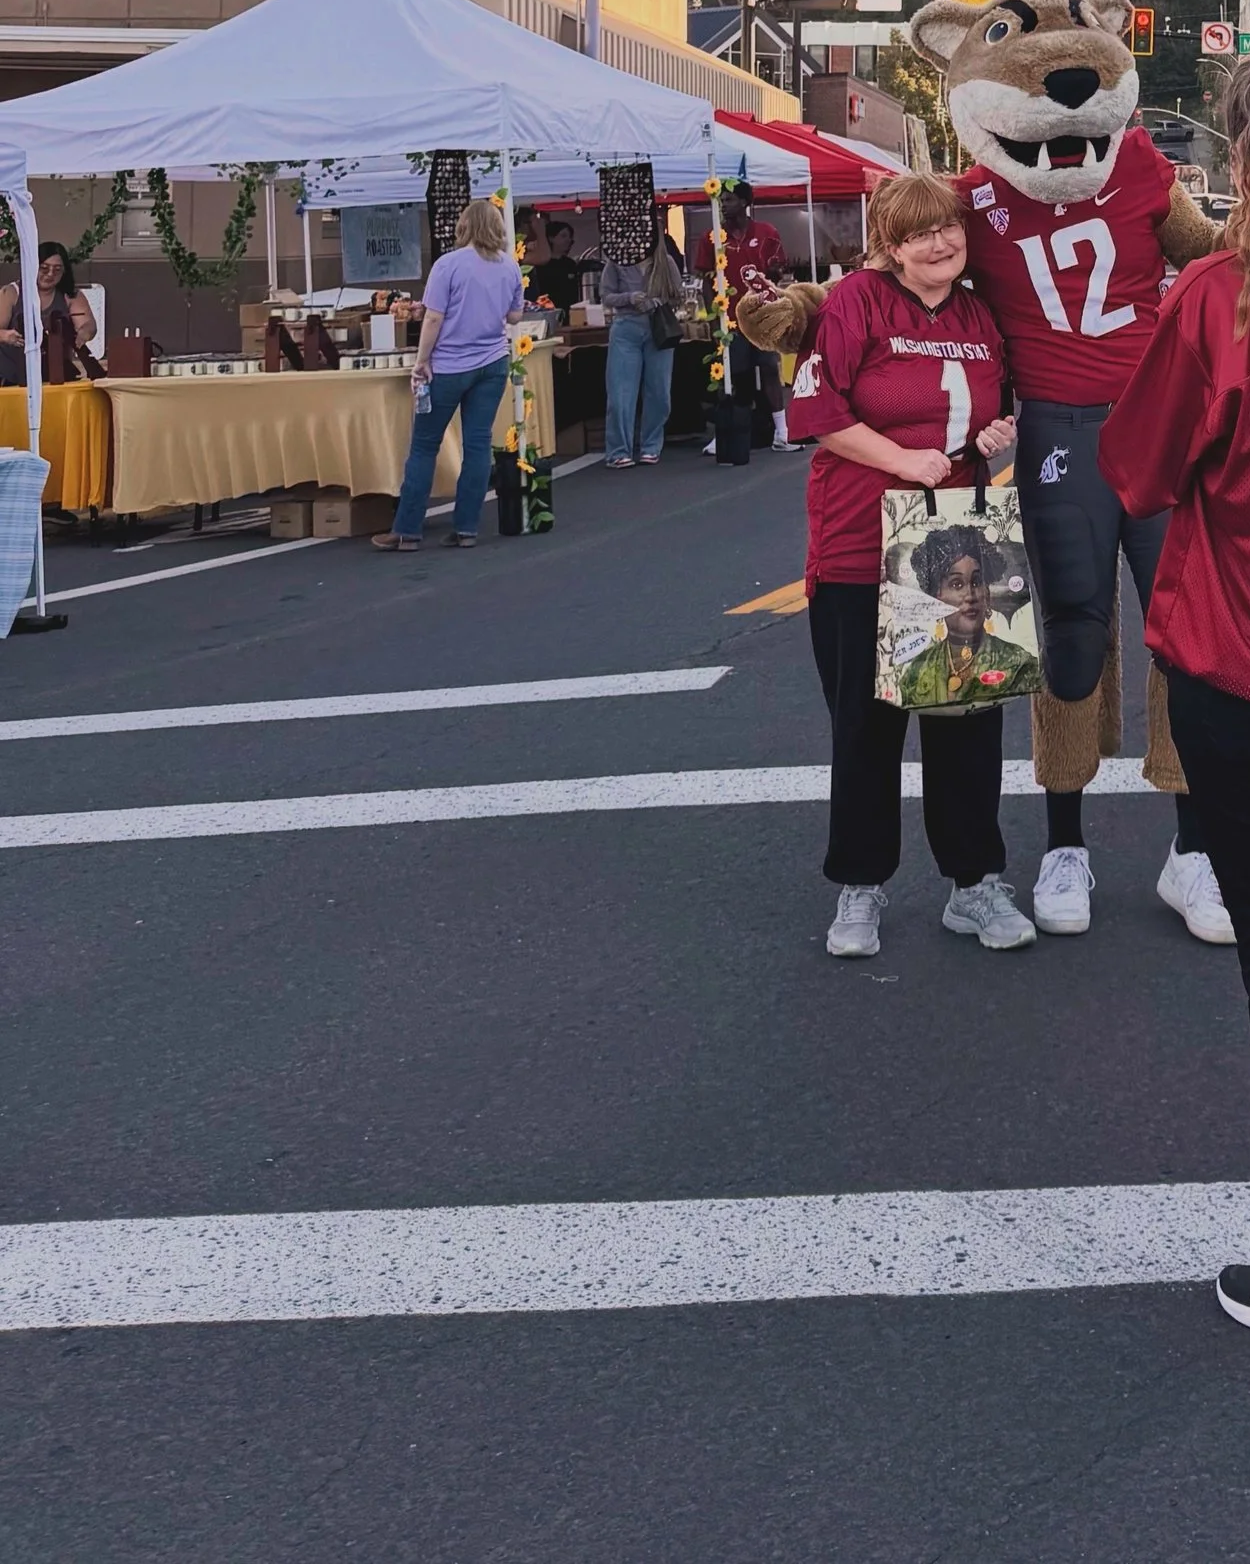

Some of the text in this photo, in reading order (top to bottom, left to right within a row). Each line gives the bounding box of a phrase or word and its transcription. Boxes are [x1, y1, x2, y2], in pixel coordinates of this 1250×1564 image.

[366, 239, 403, 257] ROASTERS
[1013, 218, 1137, 337] 12
[889, 336, 964, 359] WASHINGTON
[940, 359, 972, 456] 1
